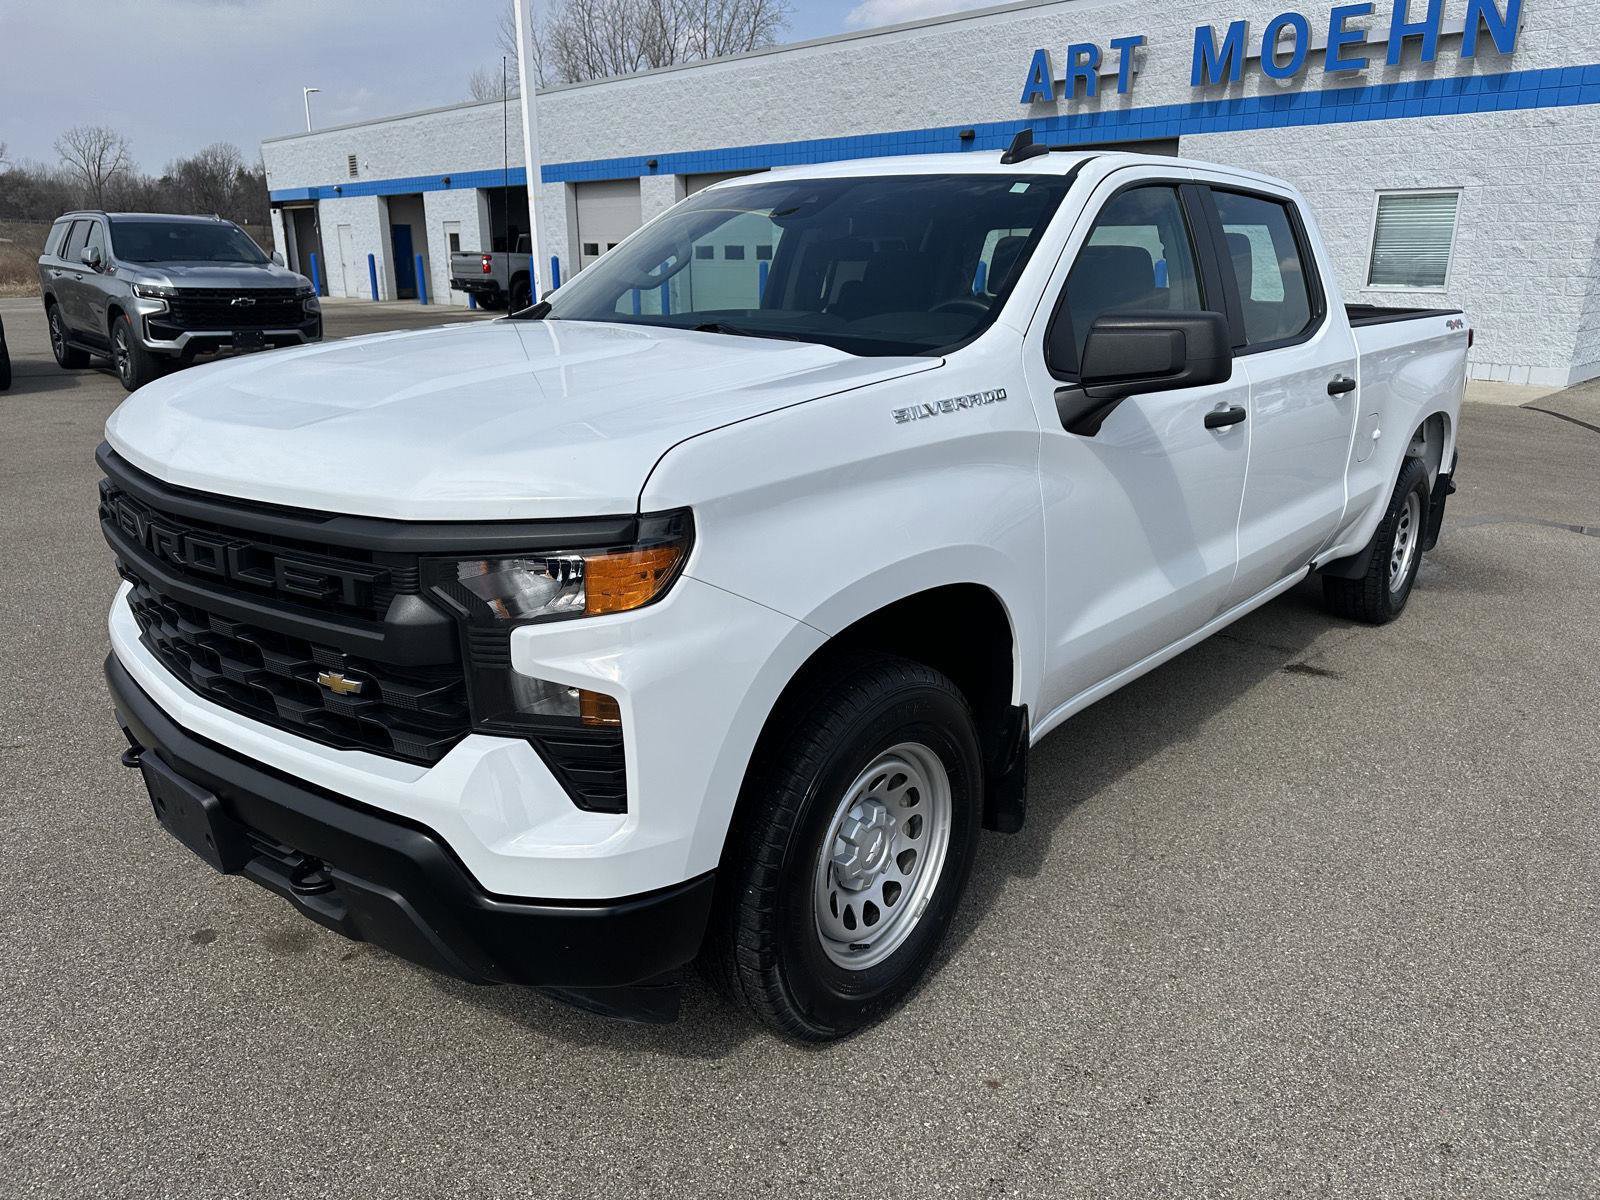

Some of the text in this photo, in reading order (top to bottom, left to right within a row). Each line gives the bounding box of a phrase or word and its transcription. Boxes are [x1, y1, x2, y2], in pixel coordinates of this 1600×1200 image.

[1021, 0, 1523, 104] ART MOEHN
[891, 388, 1007, 423] SILVERADO
[99, 481, 390, 606] HEVROLET
